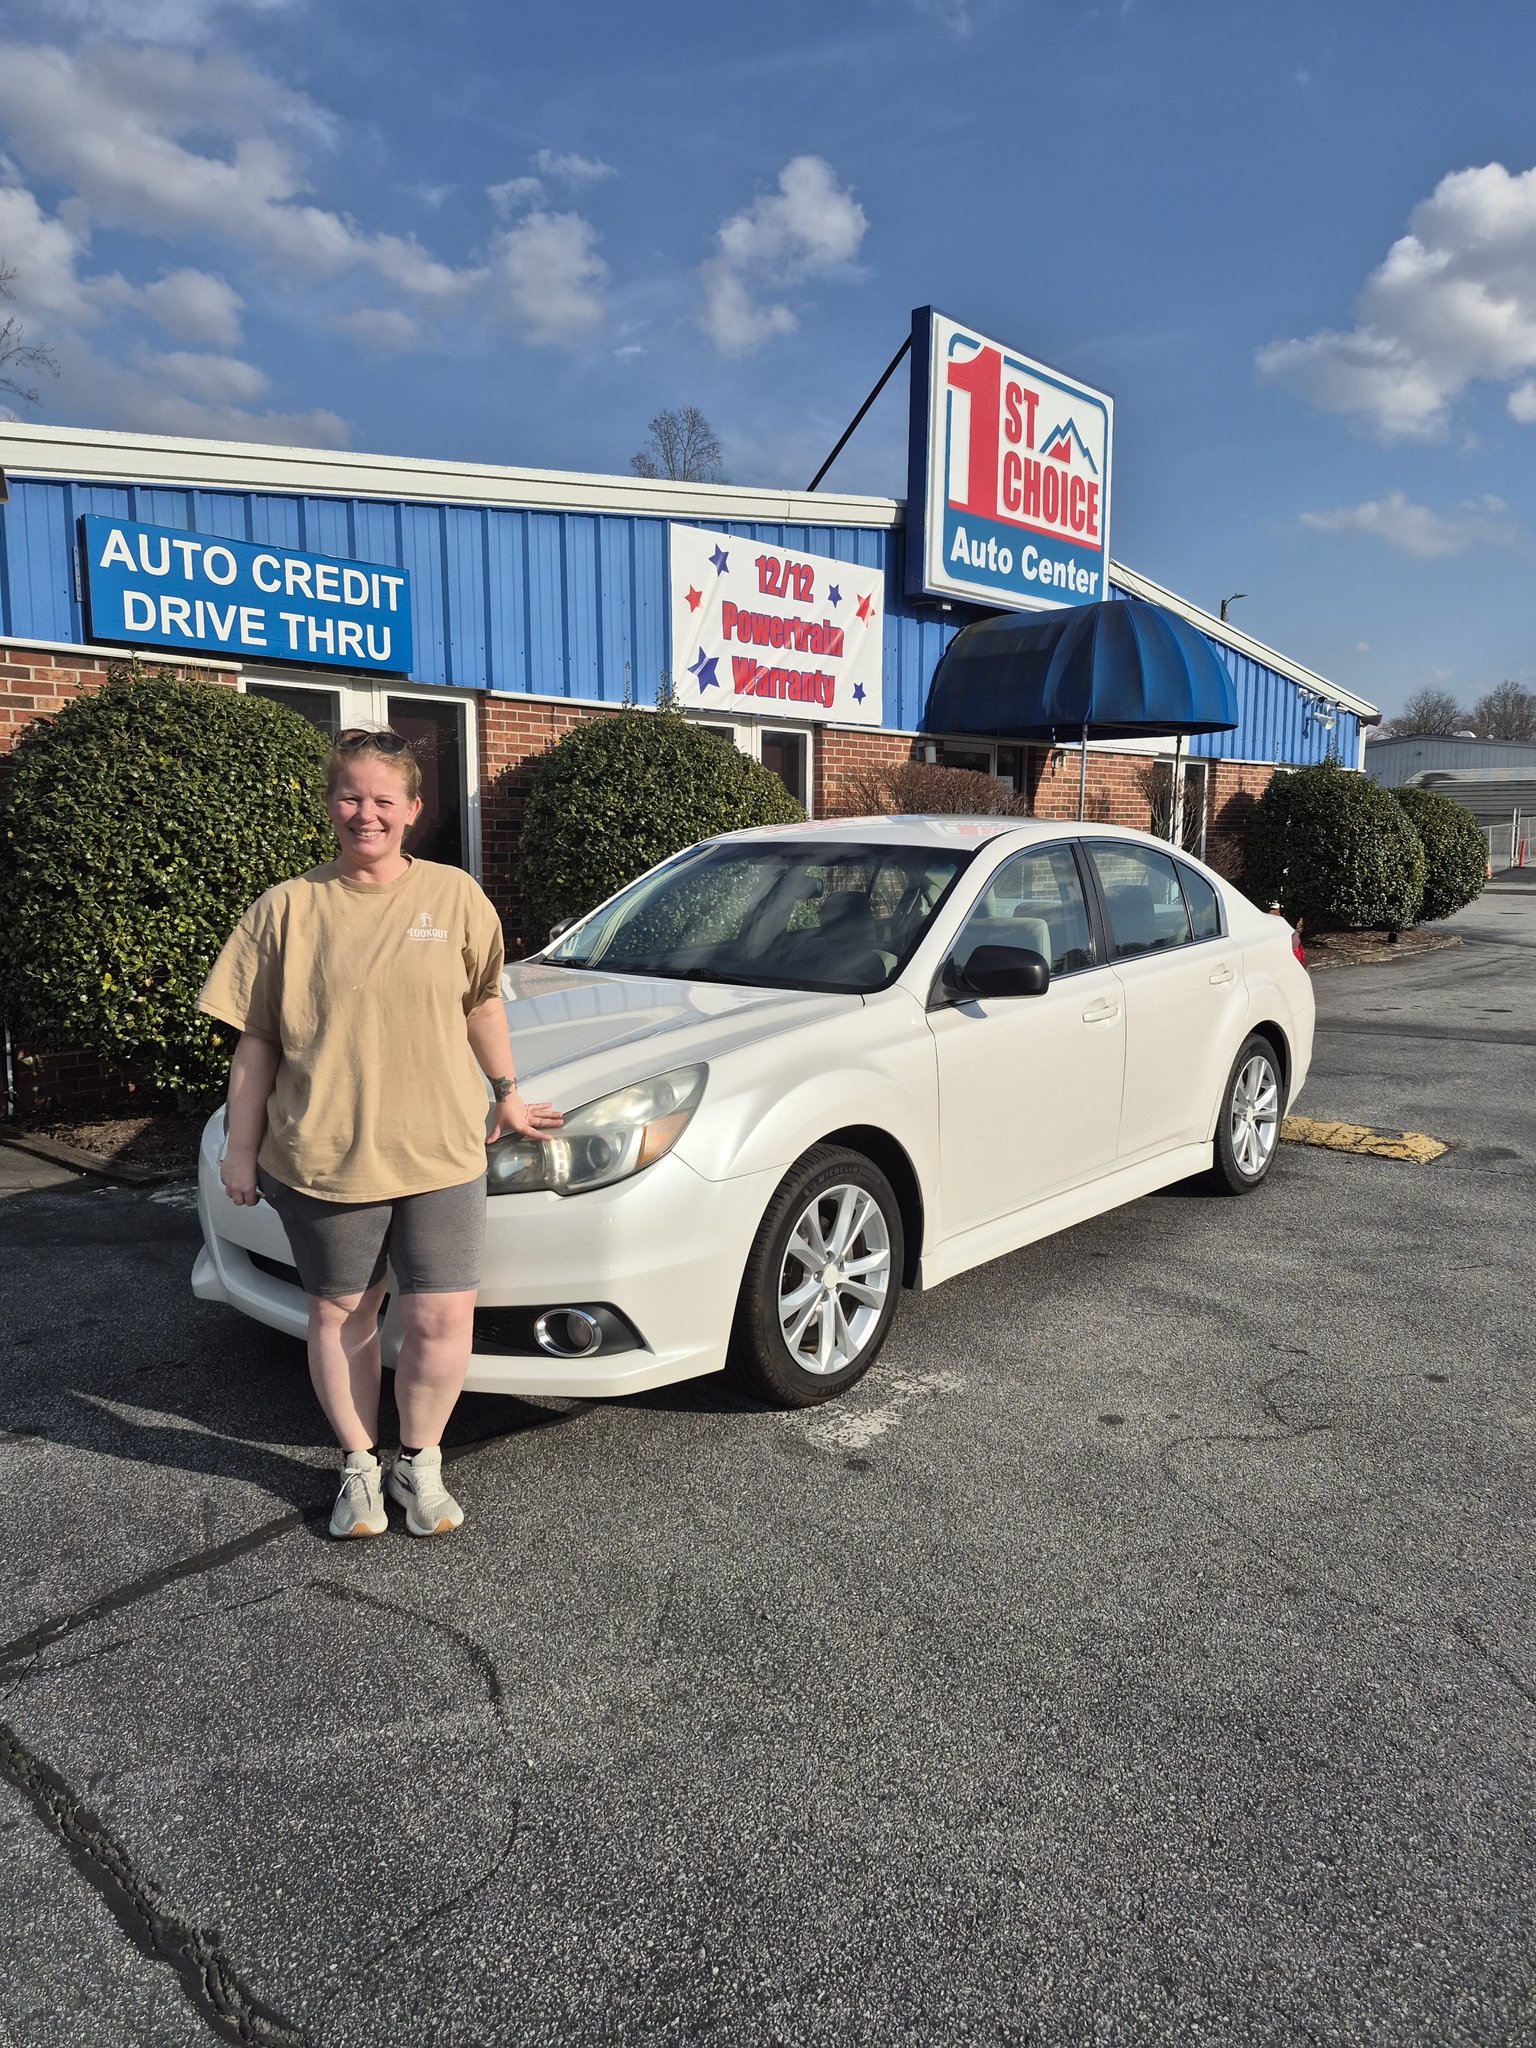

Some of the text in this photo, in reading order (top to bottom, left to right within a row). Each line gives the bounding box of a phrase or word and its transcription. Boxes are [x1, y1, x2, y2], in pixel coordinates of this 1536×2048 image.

[1003, 450, 1099, 536] CHOICE
[100, 529, 404, 611] AUTO CREDIT
[755, 554, 815, 603] 12/12
[950, 526, 1099, 595] Auto Center
[123, 590, 391, 661] DRIVE THRU
[722, 600, 844, 658] Powertrain
[731, 655, 835, 708] Warranty
